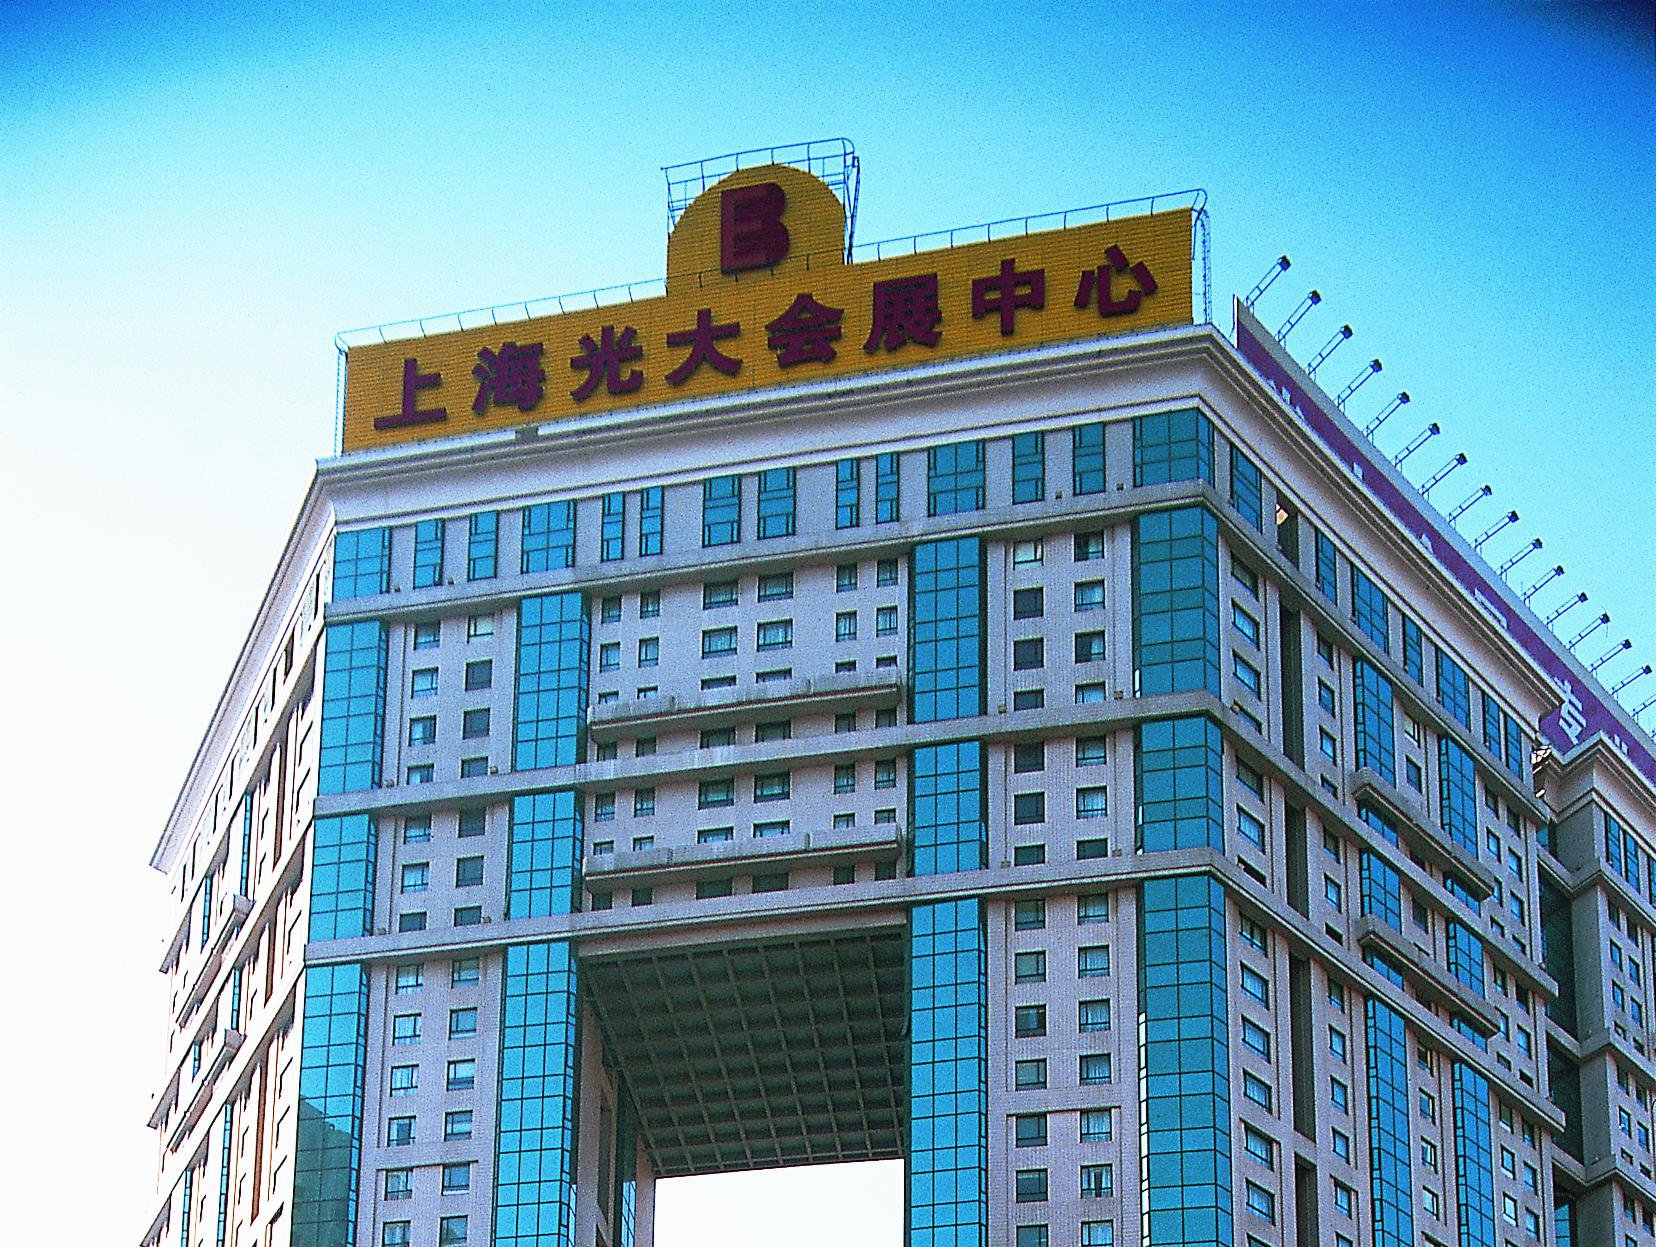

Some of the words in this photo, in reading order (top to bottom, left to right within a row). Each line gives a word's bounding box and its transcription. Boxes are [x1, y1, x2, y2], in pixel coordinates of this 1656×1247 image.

[720, 183, 790, 275] B
[374, 245, 1158, 431] 上海光大会展中心
